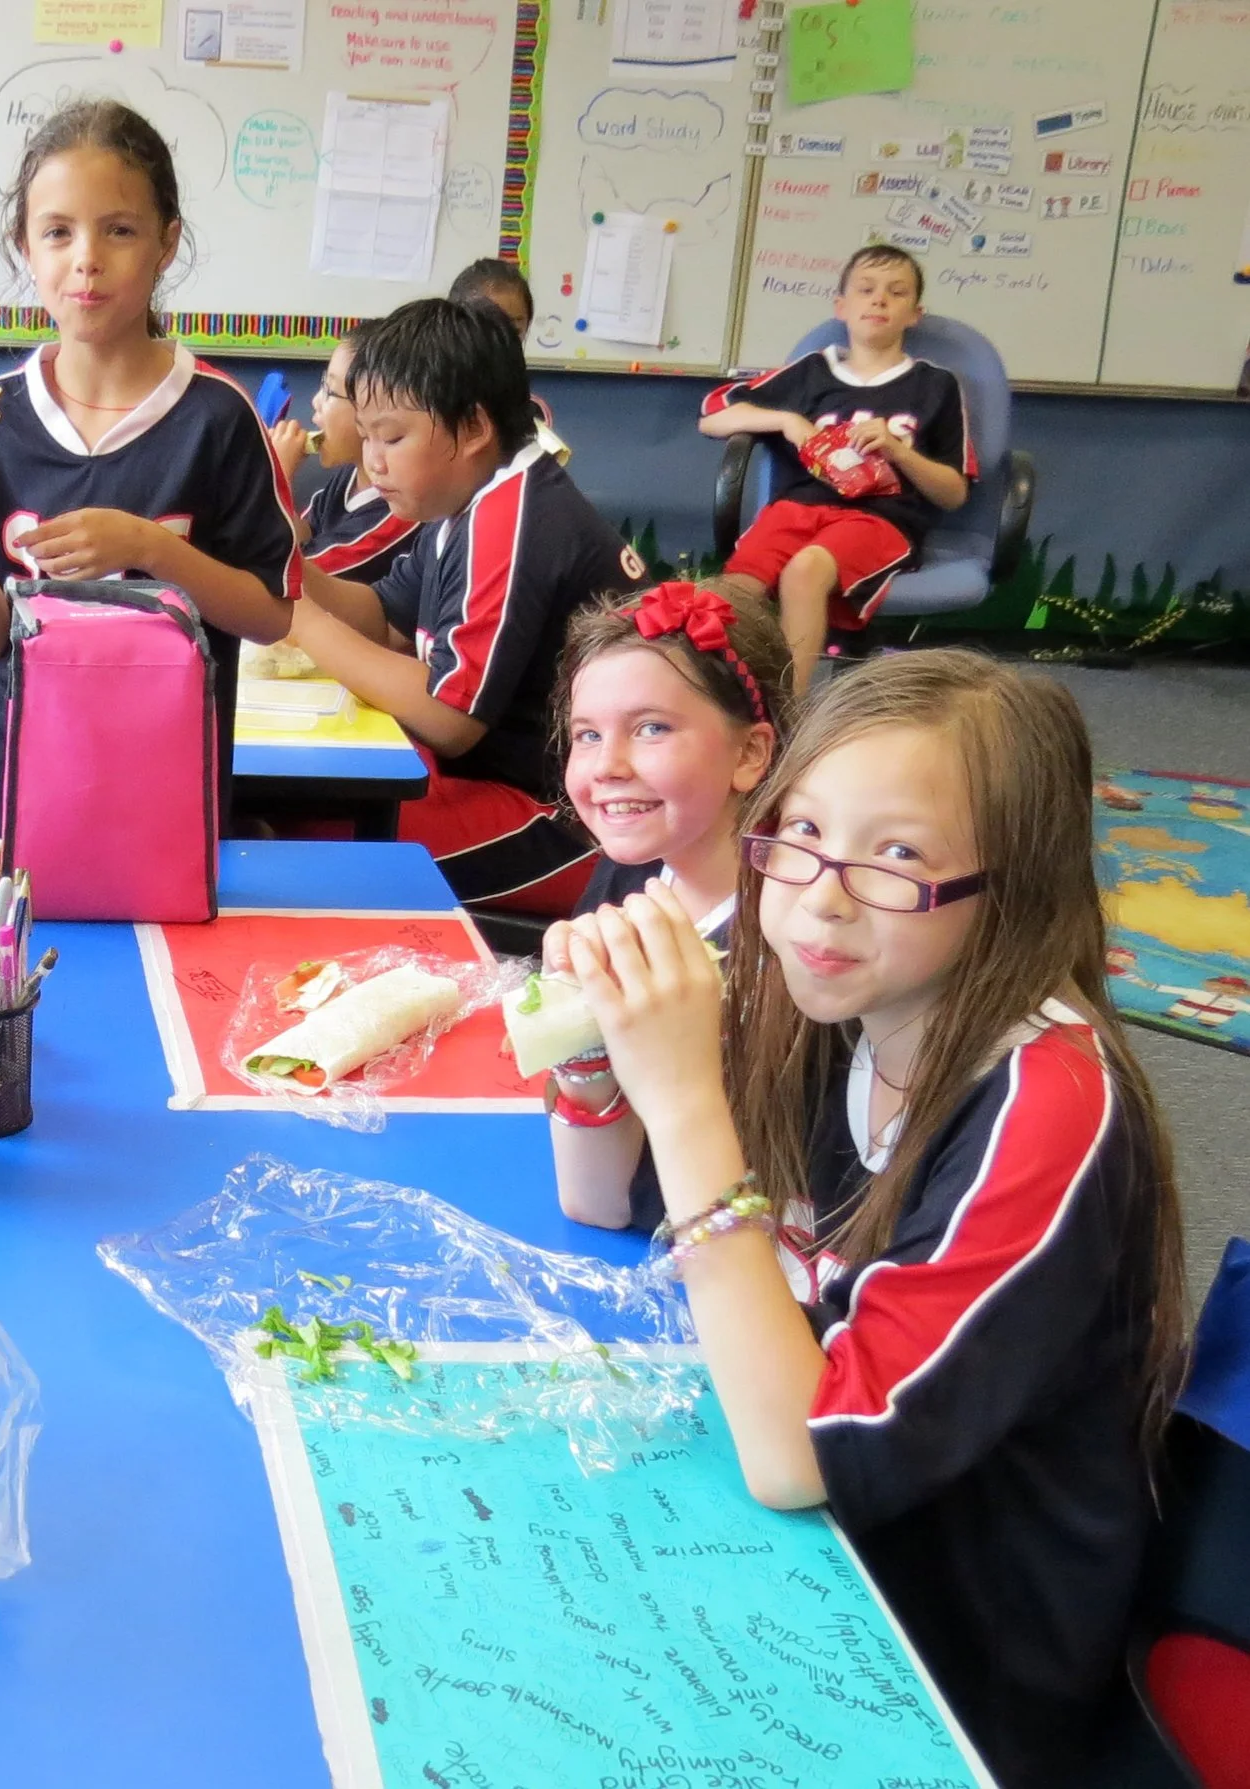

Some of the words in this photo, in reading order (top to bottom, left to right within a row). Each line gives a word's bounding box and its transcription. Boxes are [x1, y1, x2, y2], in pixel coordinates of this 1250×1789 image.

[651, 1541, 774, 1559] porcupine
[747, 1611, 839, 1661] produce
[750, 1702, 843, 1763] greedy
[619, 1745, 736, 1778] almighty
